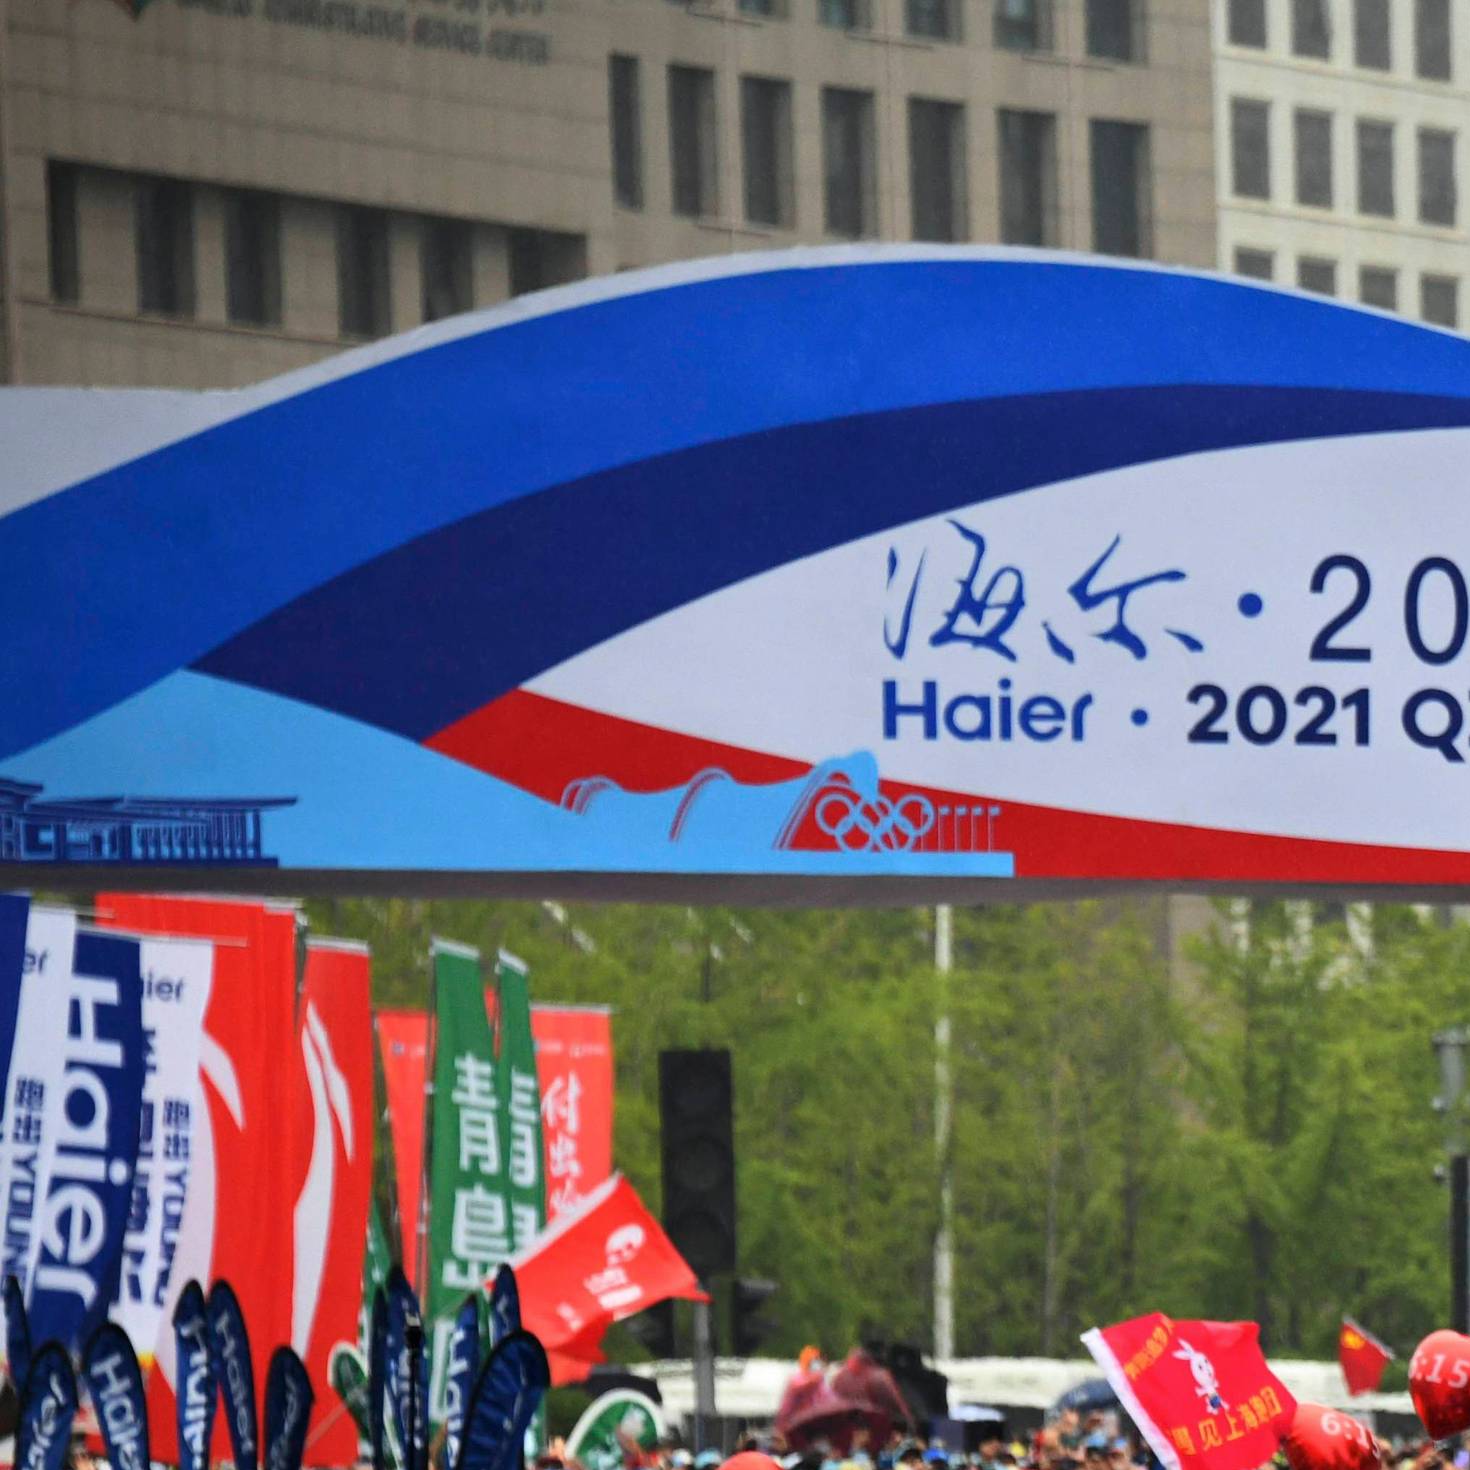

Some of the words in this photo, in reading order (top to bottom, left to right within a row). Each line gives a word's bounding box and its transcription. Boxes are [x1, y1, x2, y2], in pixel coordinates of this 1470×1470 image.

[884, 519, 1204, 662] 海尔
[883, 679, 1093, 741] Haier
[1187, 684, 1370, 746] 2021
[34, 974, 131, 1311] Haier
